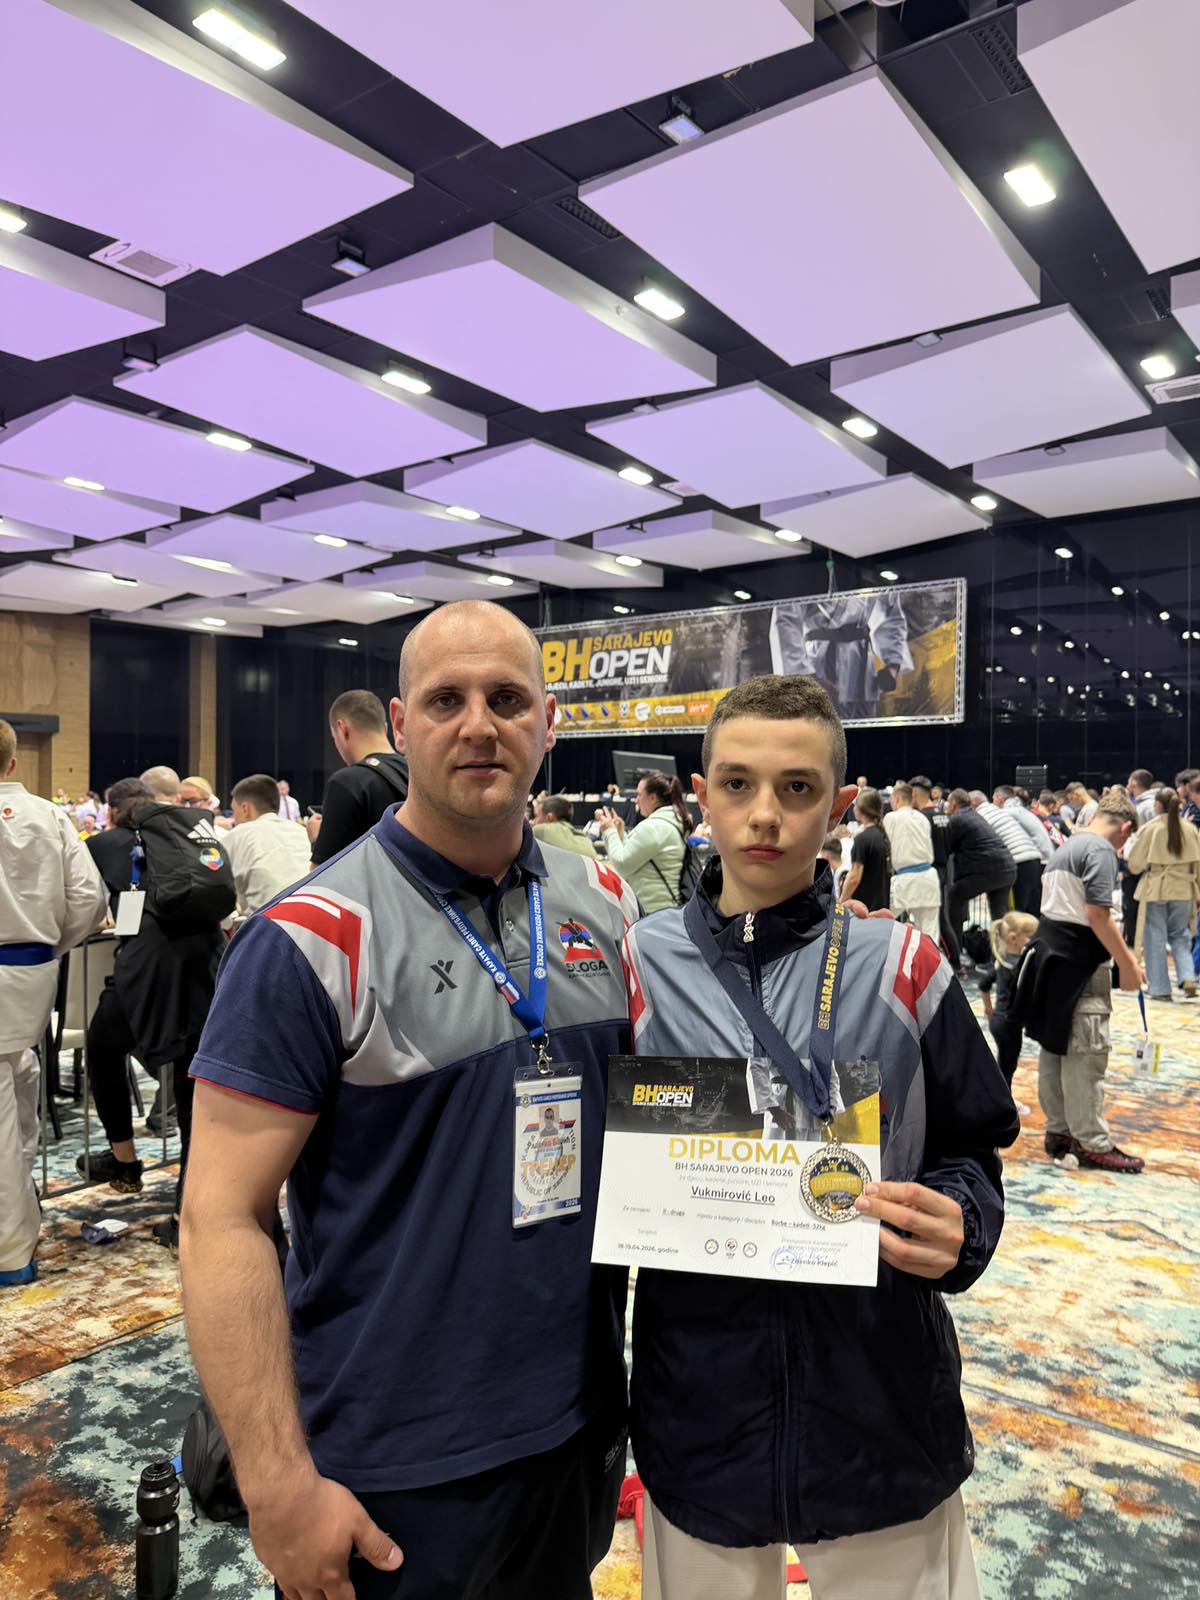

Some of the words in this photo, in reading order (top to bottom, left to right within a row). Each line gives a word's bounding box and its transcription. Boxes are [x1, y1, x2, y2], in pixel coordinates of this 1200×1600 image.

[593, 629, 673, 652] SARAJEVO
[542, 637, 593, 683] BH
[589, 645, 673, 680] OPEN
[445, 906, 469, 935] РЕПУБЛИКЕ
[465, 935, 482, 951] САВЕЗ
[479, 949, 498, 974] КАРАТЕ
[820, 946, 840, 1012] SARAJEVO
[632, 1084, 659, 1104] BH
[656, 1091, 694, 1104] OPEN
[658, 1085, 694, 1093] SARAJEVO
[668, 1137, 801, 1167] DIPLOMA
[674, 1162, 688, 1171] BH
[690, 1163, 740, 1174] SARAJEVO
[741, 1166, 768, 1177] OPEN
[769, 1167, 794, 1178] 2026
[691, 1185, 752, 1199] Vukmirović
[755, 1192, 776, 1203] Leo
[658, 1246, 679, 1255] godine
